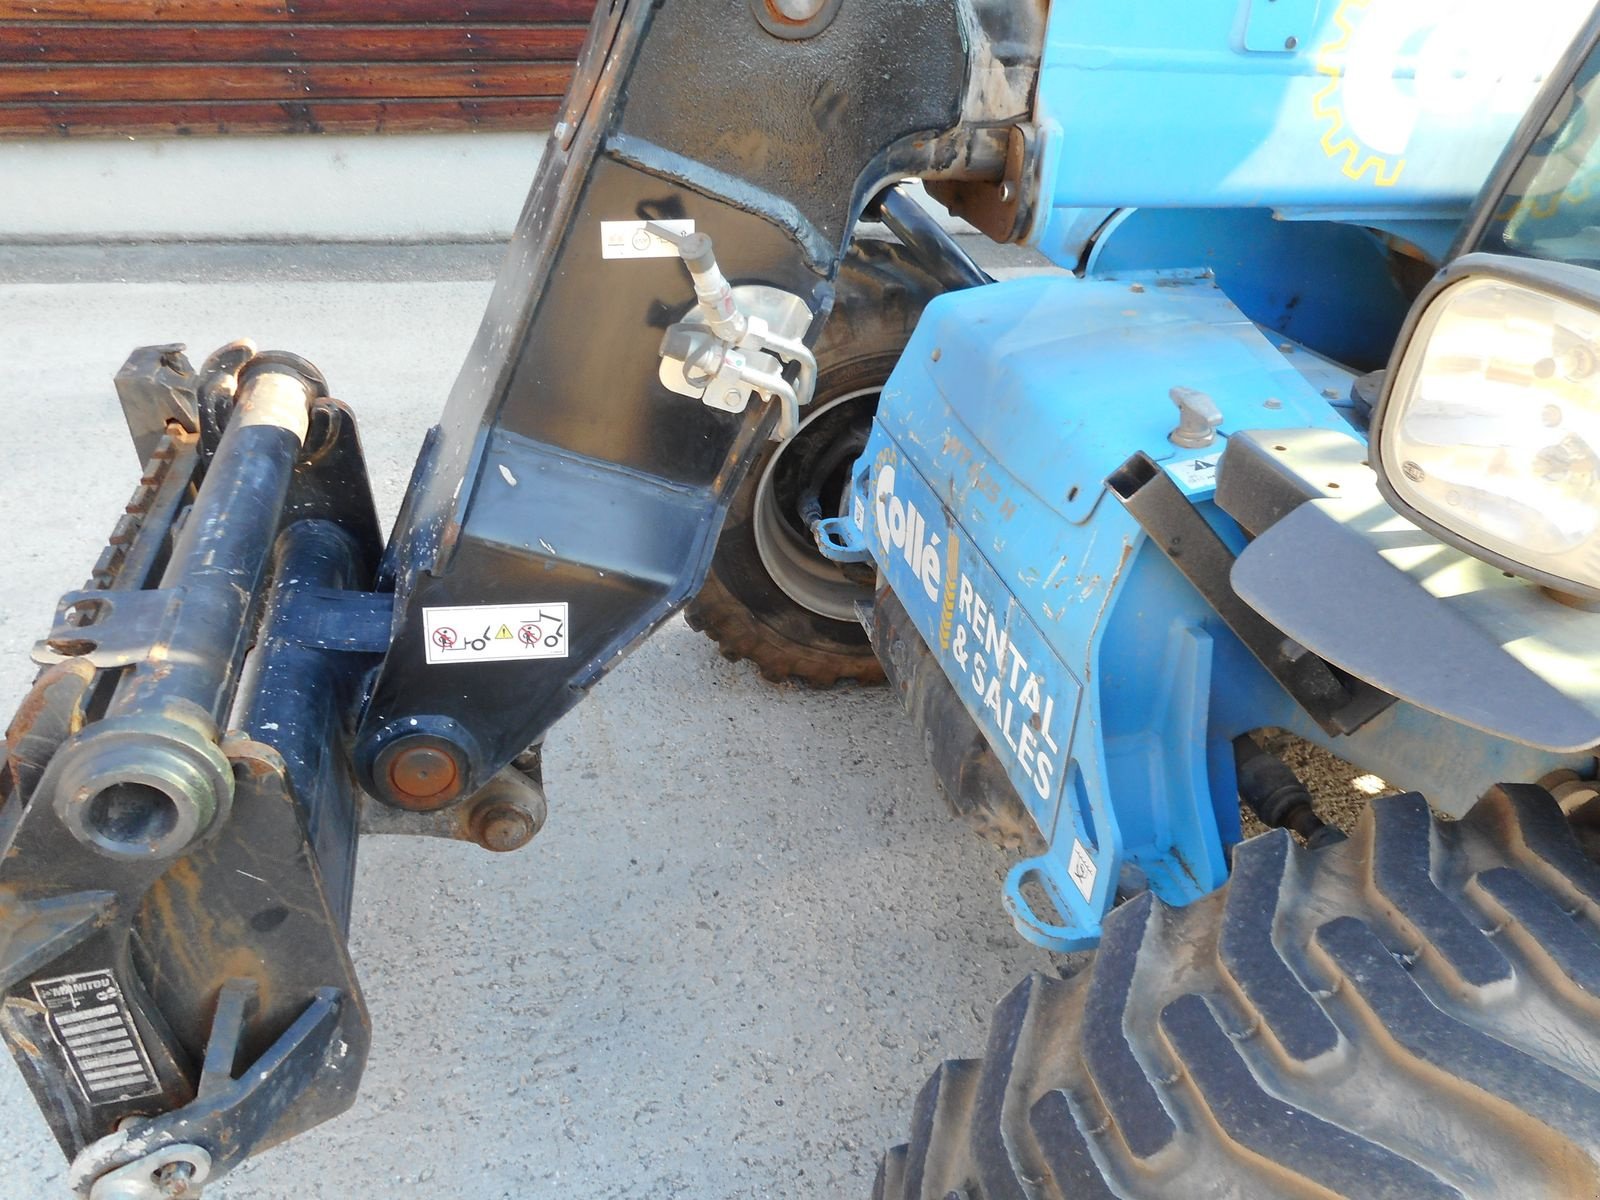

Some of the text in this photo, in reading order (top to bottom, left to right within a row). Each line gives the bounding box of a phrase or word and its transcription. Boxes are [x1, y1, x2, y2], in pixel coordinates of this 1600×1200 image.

[876, 464, 940, 603] Collé
[953, 625, 1054, 800] & SALES
[959, 573, 1057, 754] RENTAL
